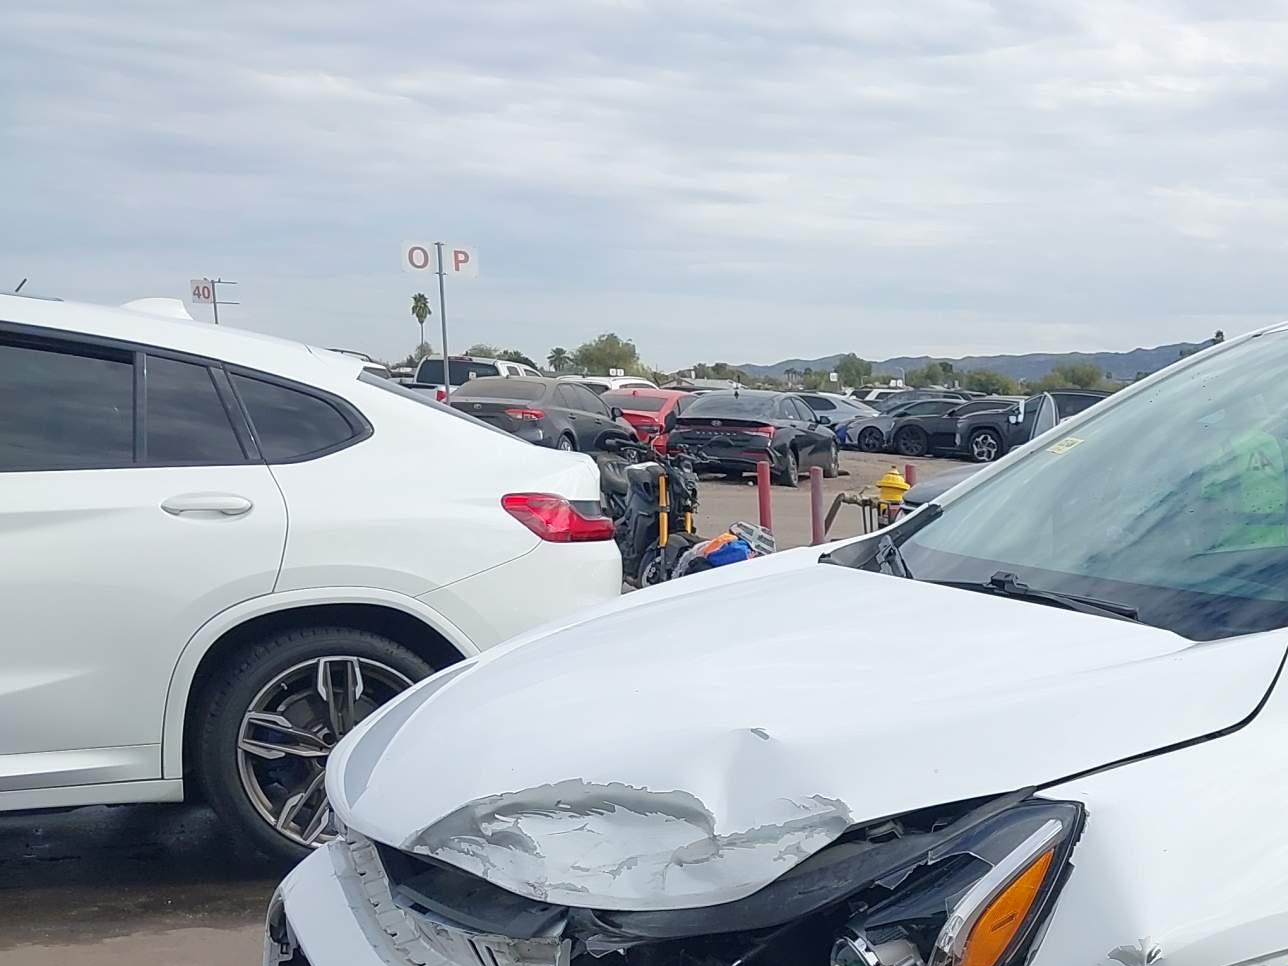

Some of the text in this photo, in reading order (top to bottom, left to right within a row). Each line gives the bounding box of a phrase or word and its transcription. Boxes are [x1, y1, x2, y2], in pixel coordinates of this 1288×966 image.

[408, 246, 430, 269] O
[453, 250, 470, 272] P
[192, 285, 211, 300] 40
